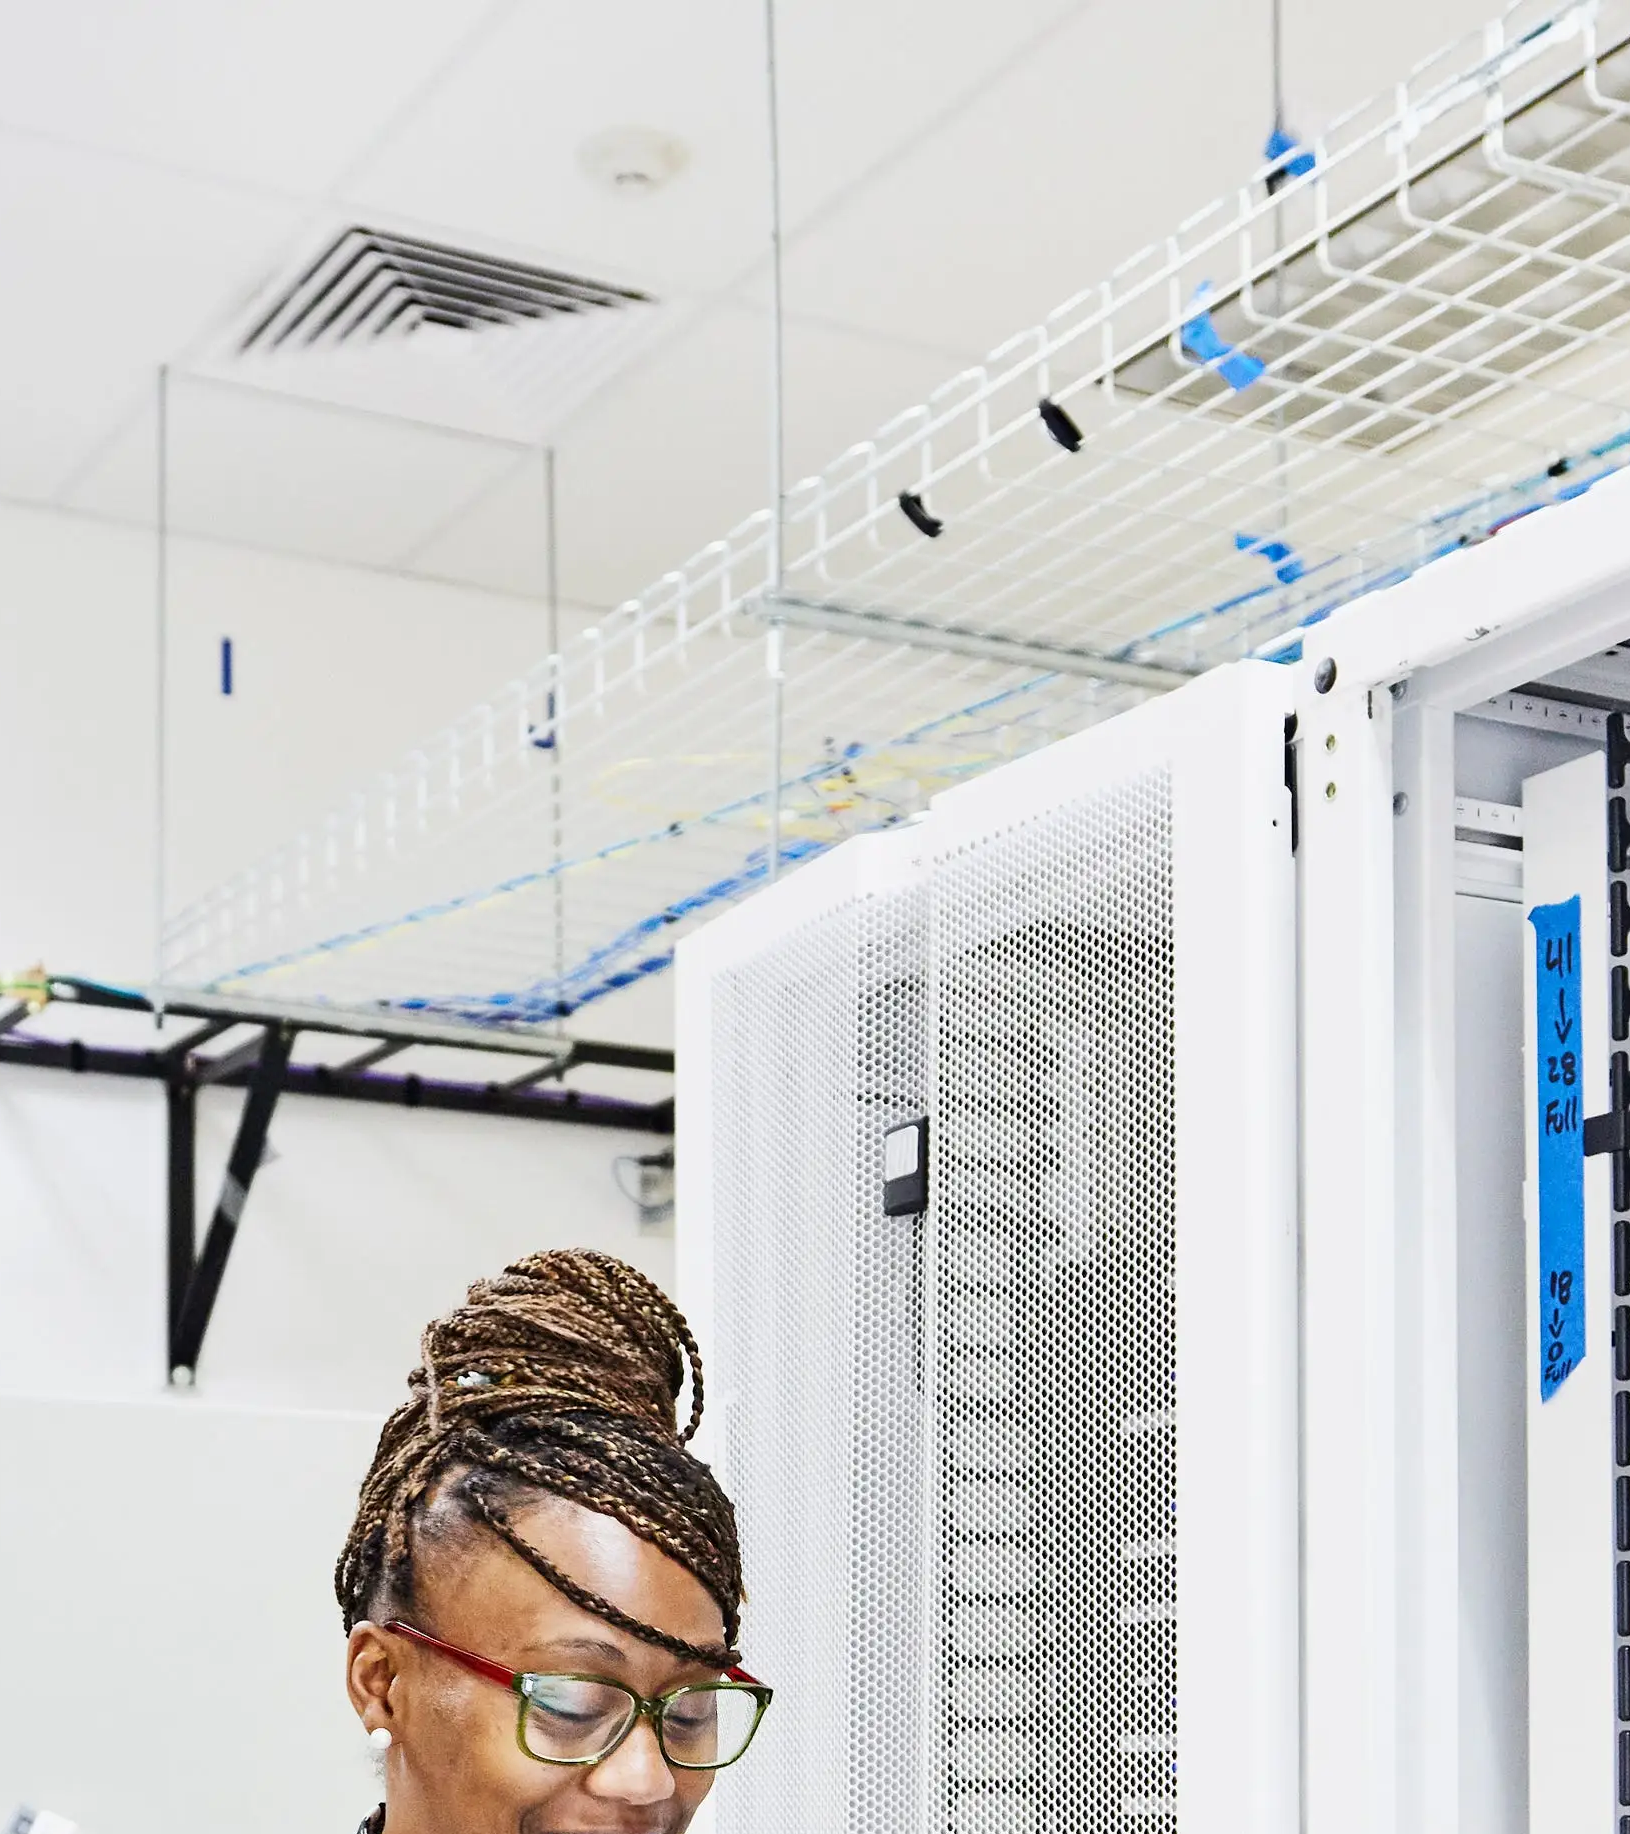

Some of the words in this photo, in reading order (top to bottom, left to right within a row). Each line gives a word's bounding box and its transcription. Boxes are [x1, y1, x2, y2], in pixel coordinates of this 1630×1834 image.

[221, 638, 232, 695] I
[1546, 932, 1573, 978] 41
[1547, 1050, 1577, 1087] 28
[1549, 1269, 1573, 1306] 18
